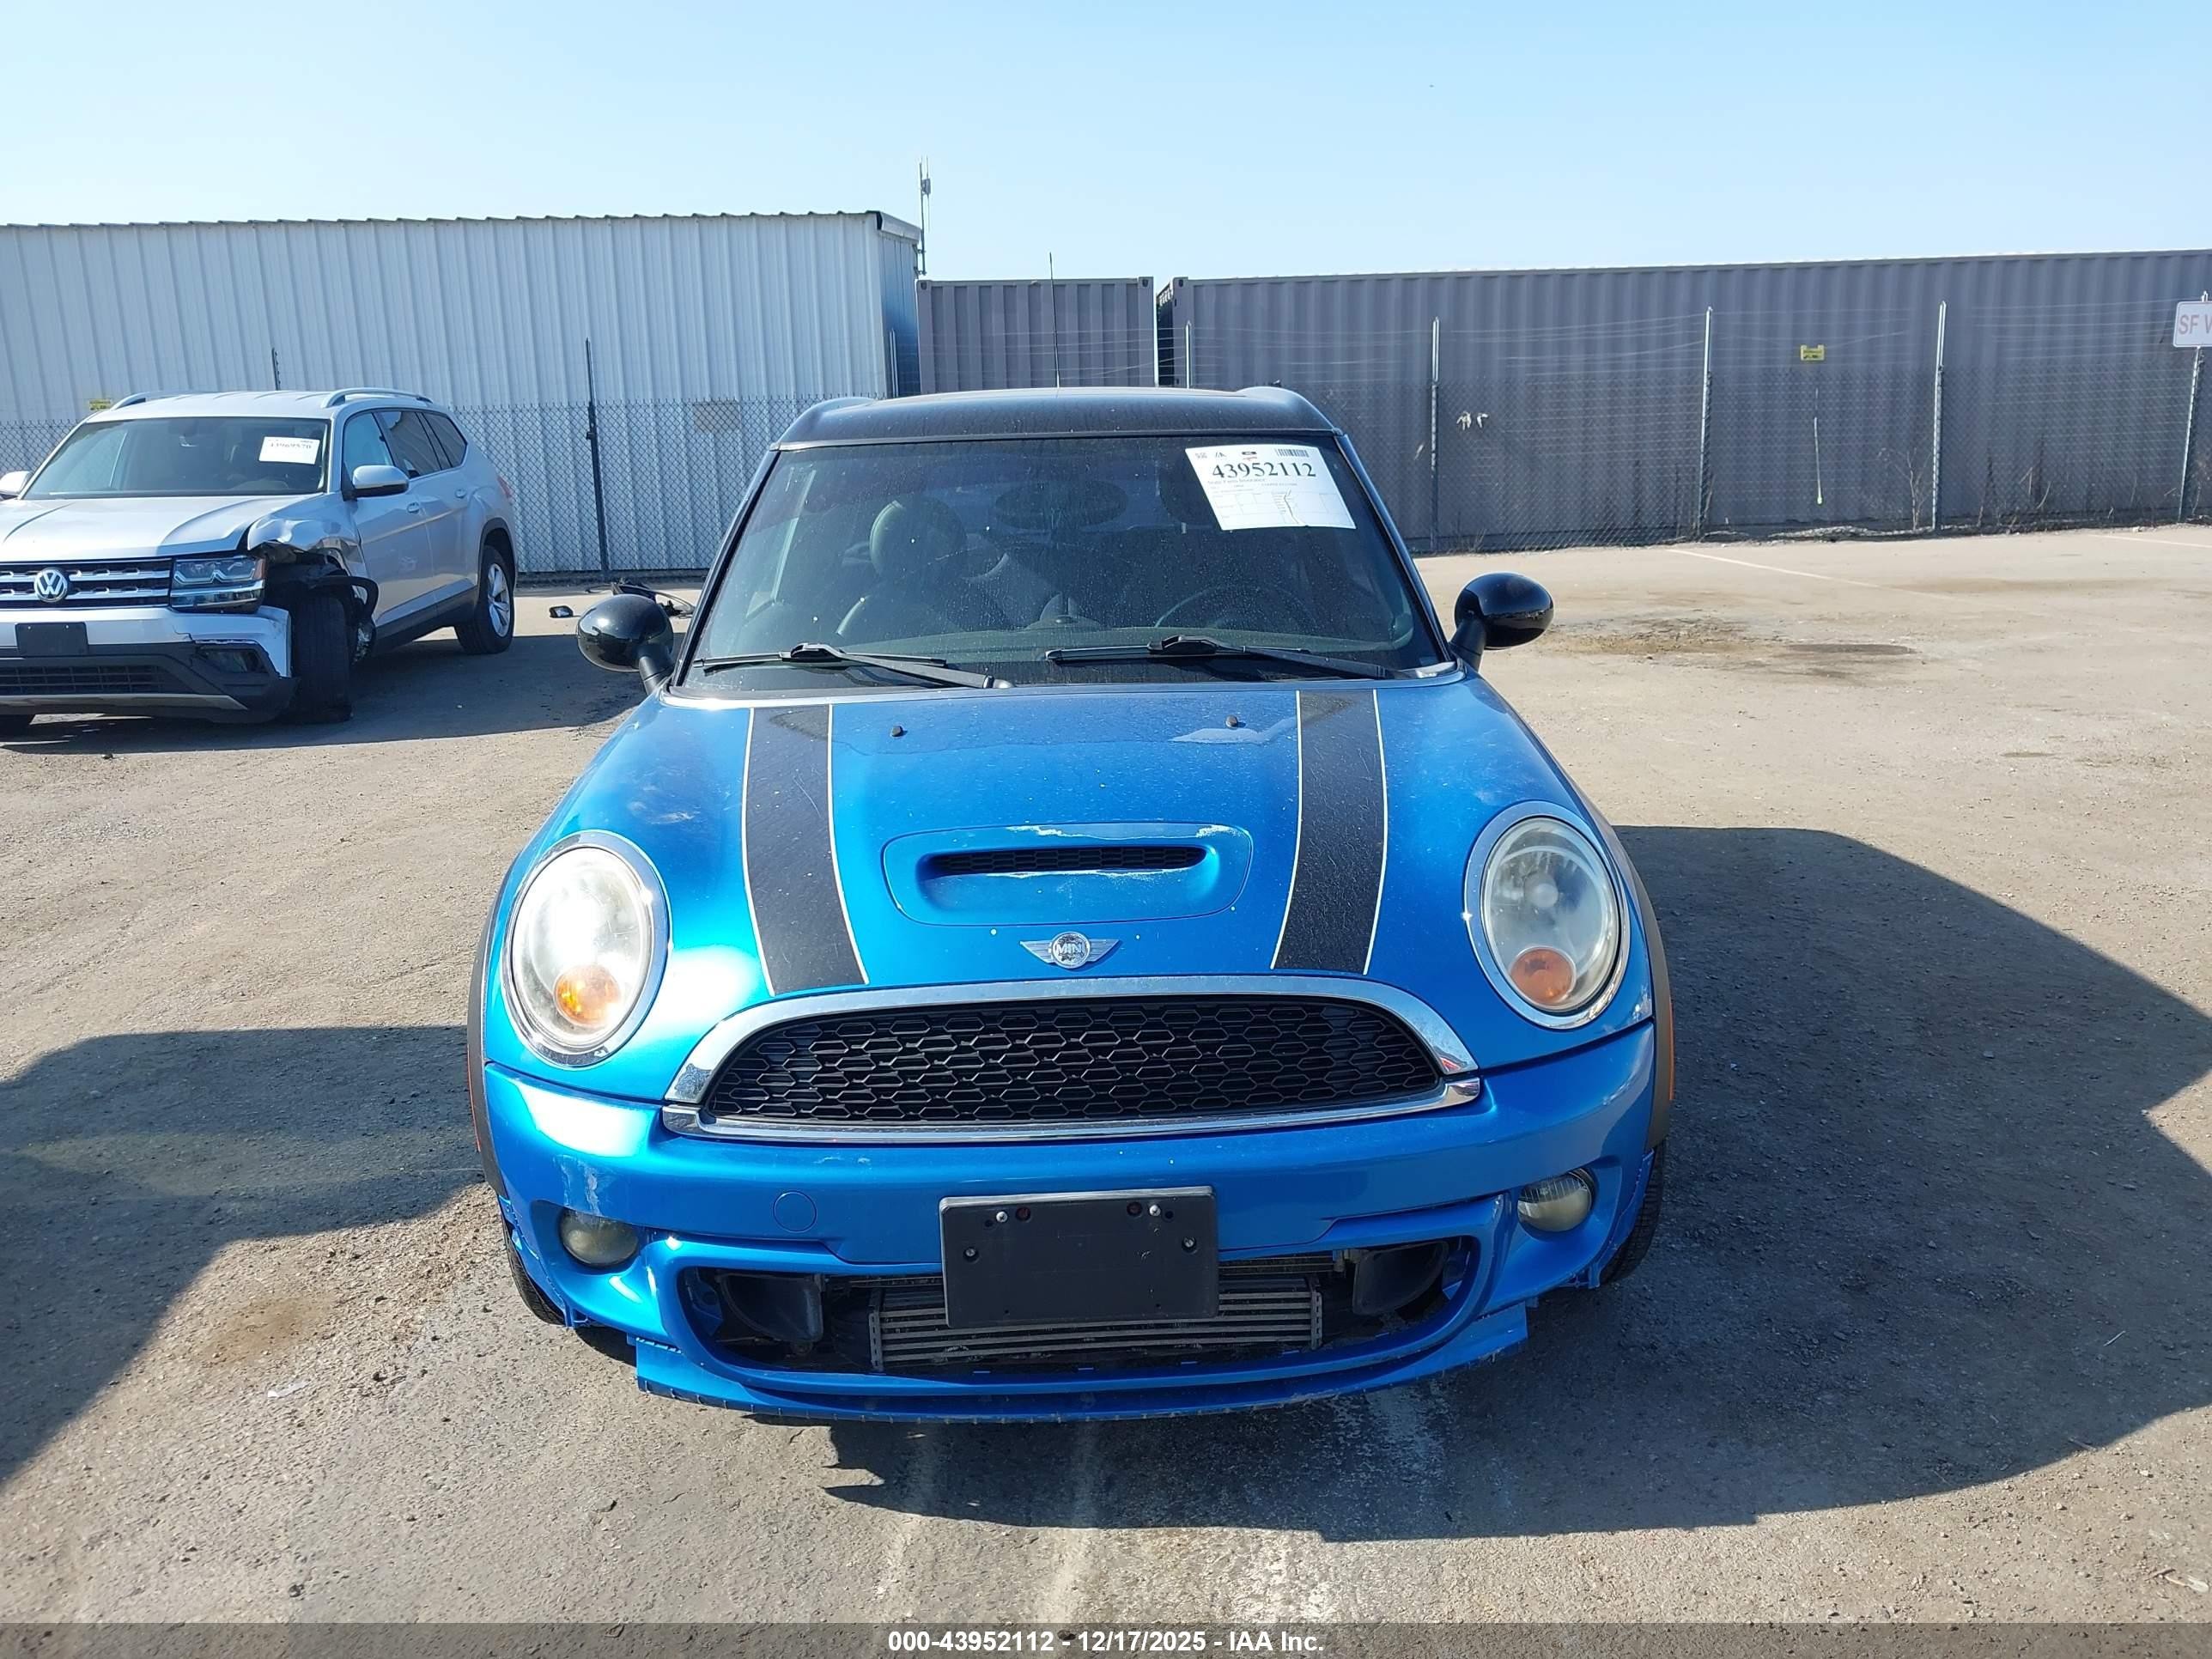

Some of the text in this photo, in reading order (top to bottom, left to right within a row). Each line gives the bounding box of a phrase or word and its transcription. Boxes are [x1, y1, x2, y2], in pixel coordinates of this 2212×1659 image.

[2179, 314, 2199, 335] SF
[1212, 461, 1316, 478] 43952112
[1055, 943, 1085, 955] MINI
